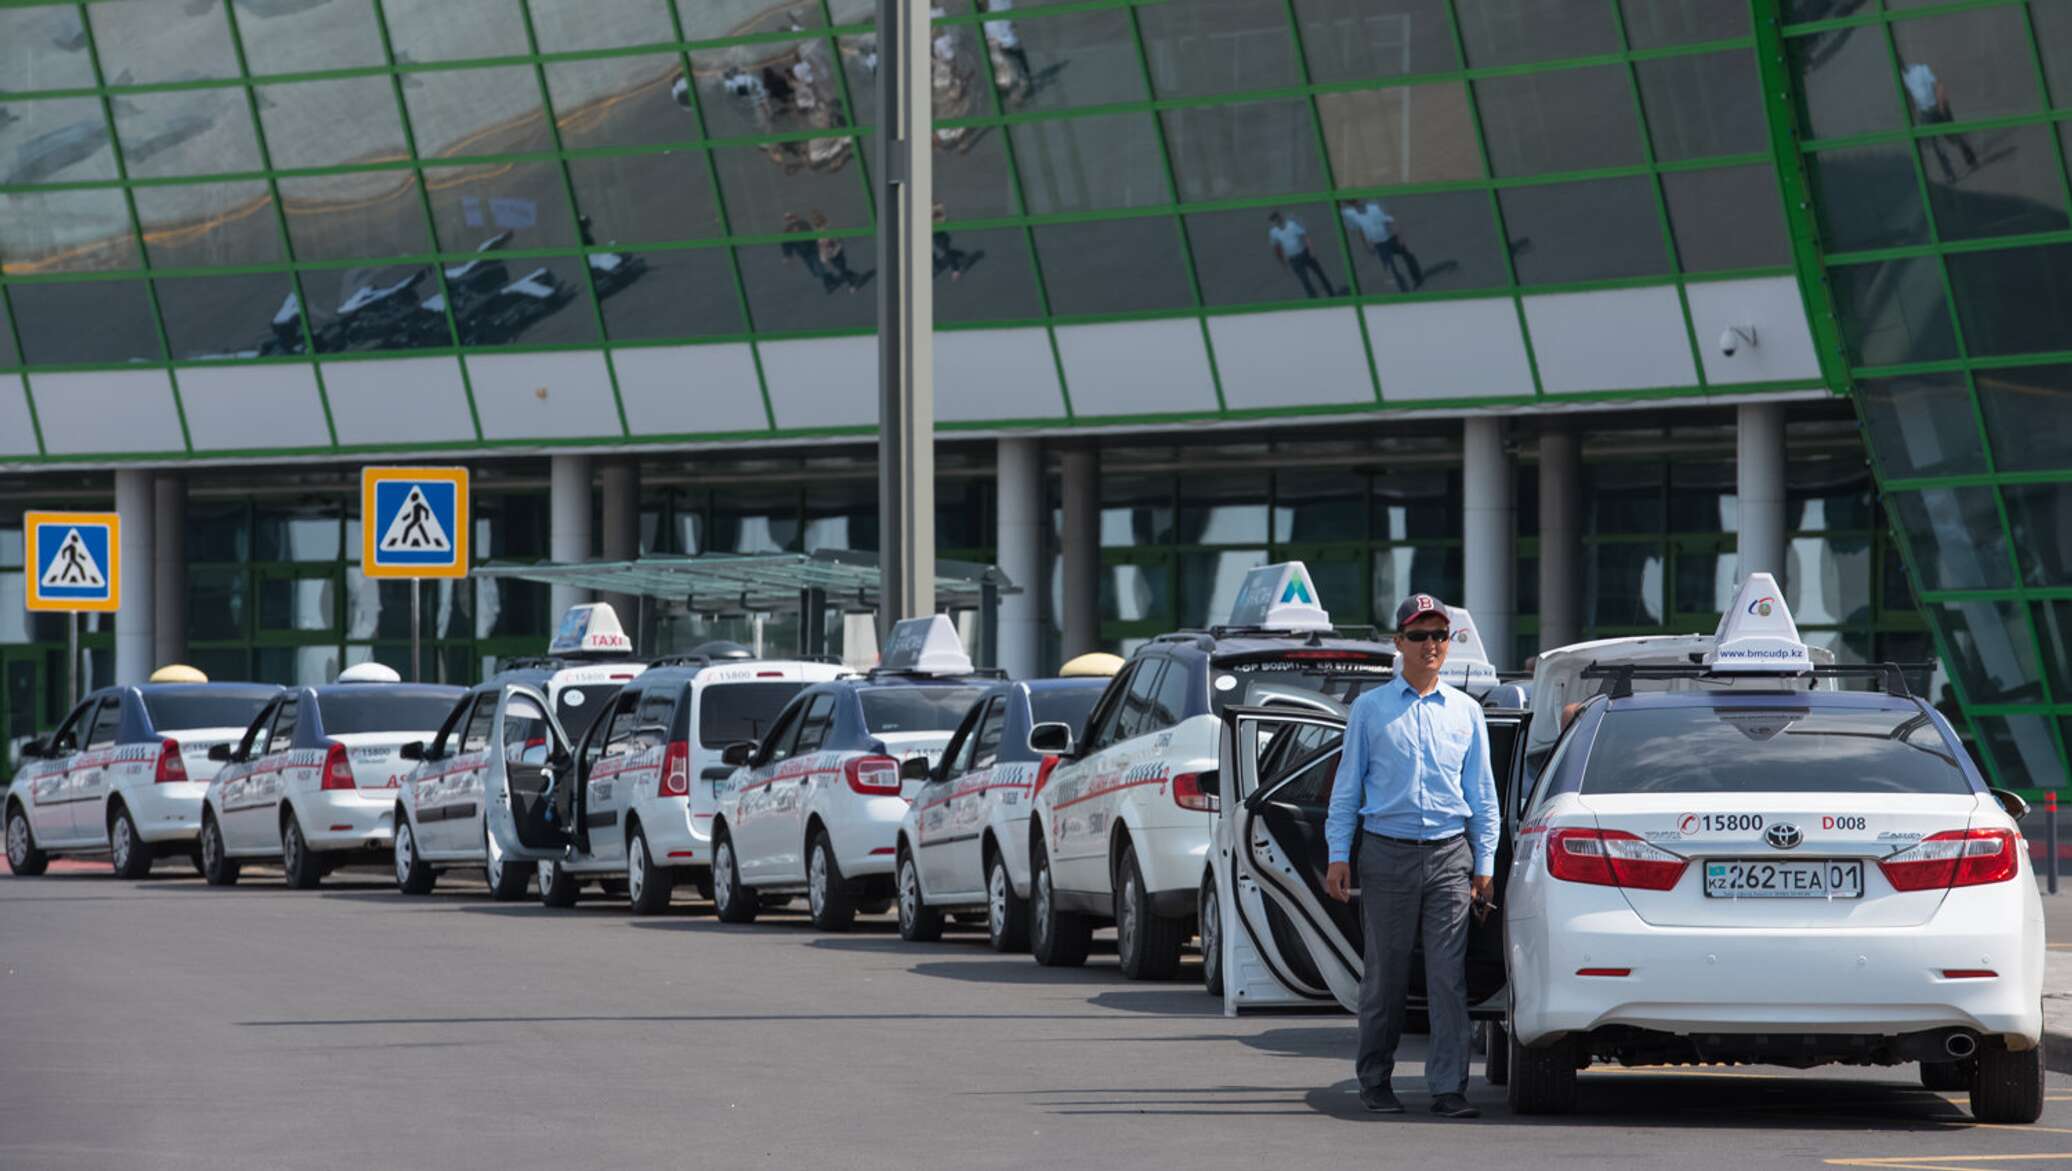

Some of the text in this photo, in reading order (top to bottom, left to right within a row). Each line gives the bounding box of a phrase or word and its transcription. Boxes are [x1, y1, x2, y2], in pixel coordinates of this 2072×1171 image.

[1416, 595, 1434, 611] B
[1720, 648, 1803, 659] www.bmcudp.kz
[719, 671, 751, 681] 15800
[1702, 814, 1763, 831] 15800
[1708, 878, 1727, 889] KZ
[1830, 865, 1858, 889] 01
